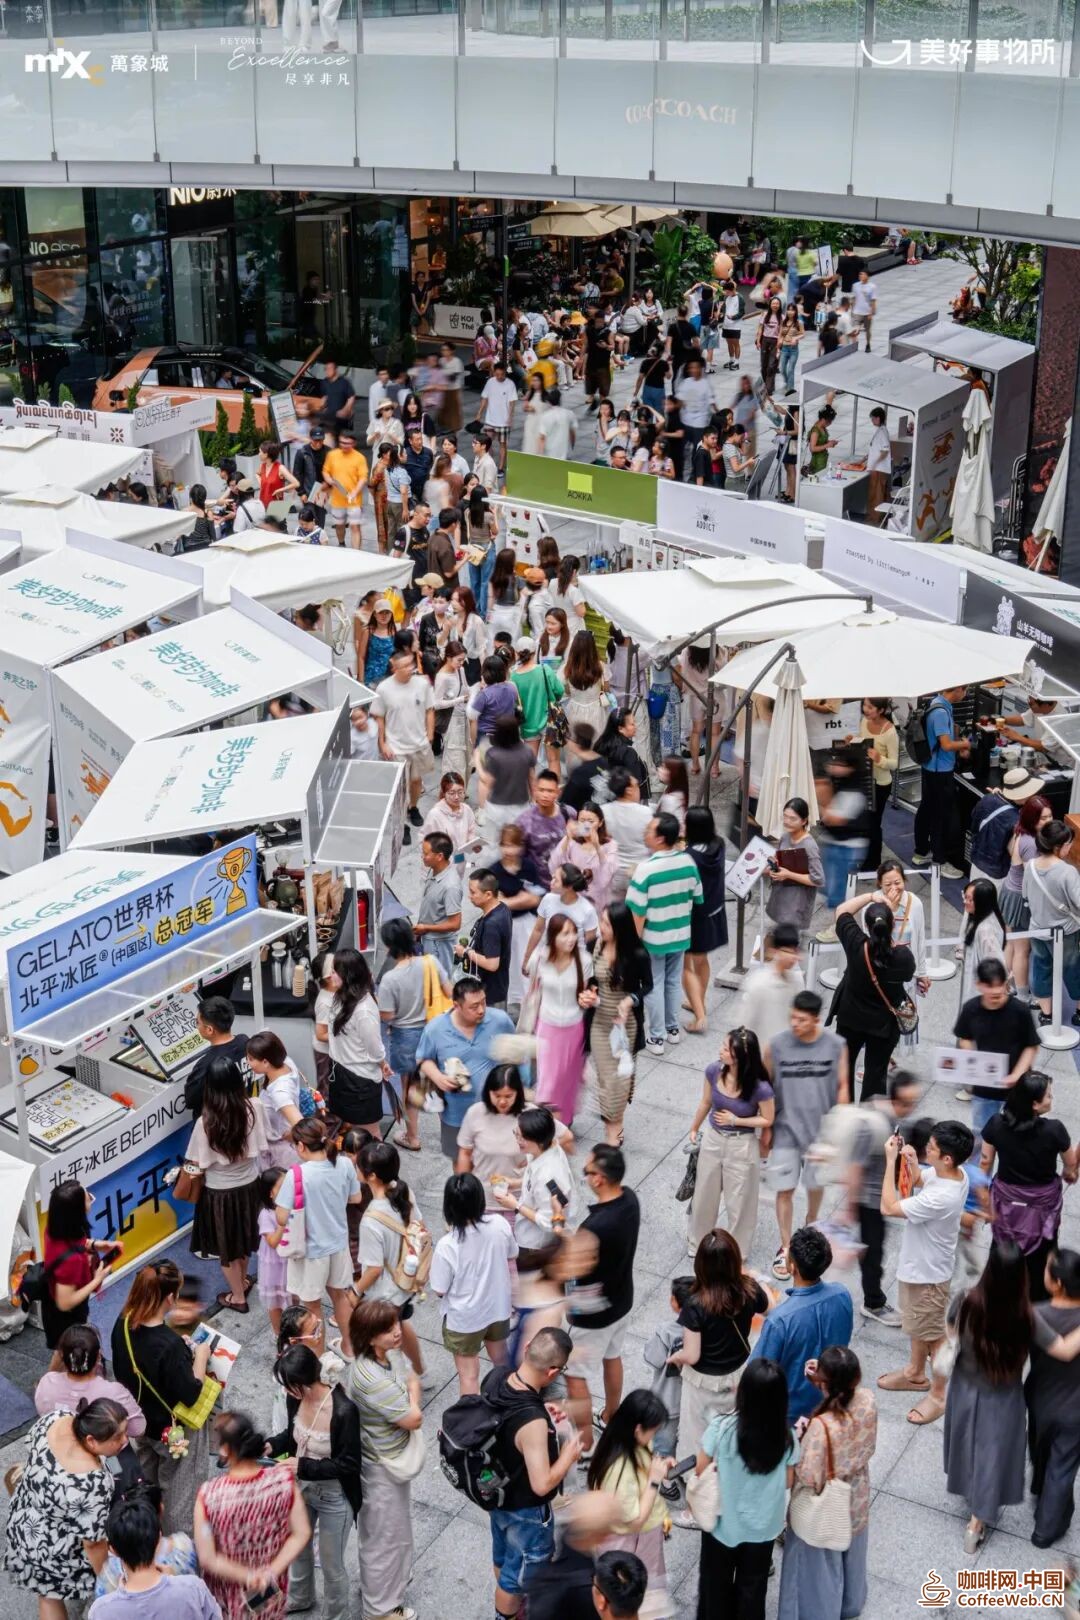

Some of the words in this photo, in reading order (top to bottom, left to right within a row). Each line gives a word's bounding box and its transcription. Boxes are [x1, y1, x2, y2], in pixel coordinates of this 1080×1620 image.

[461, 315, 474, 323] KOI
[568, 491, 593, 502] AOKKA
[696, 520, 716, 533] ADDICT
[156, 897, 214, 944] 总冠军
[151, 1008, 195, 1037] BEIPING
